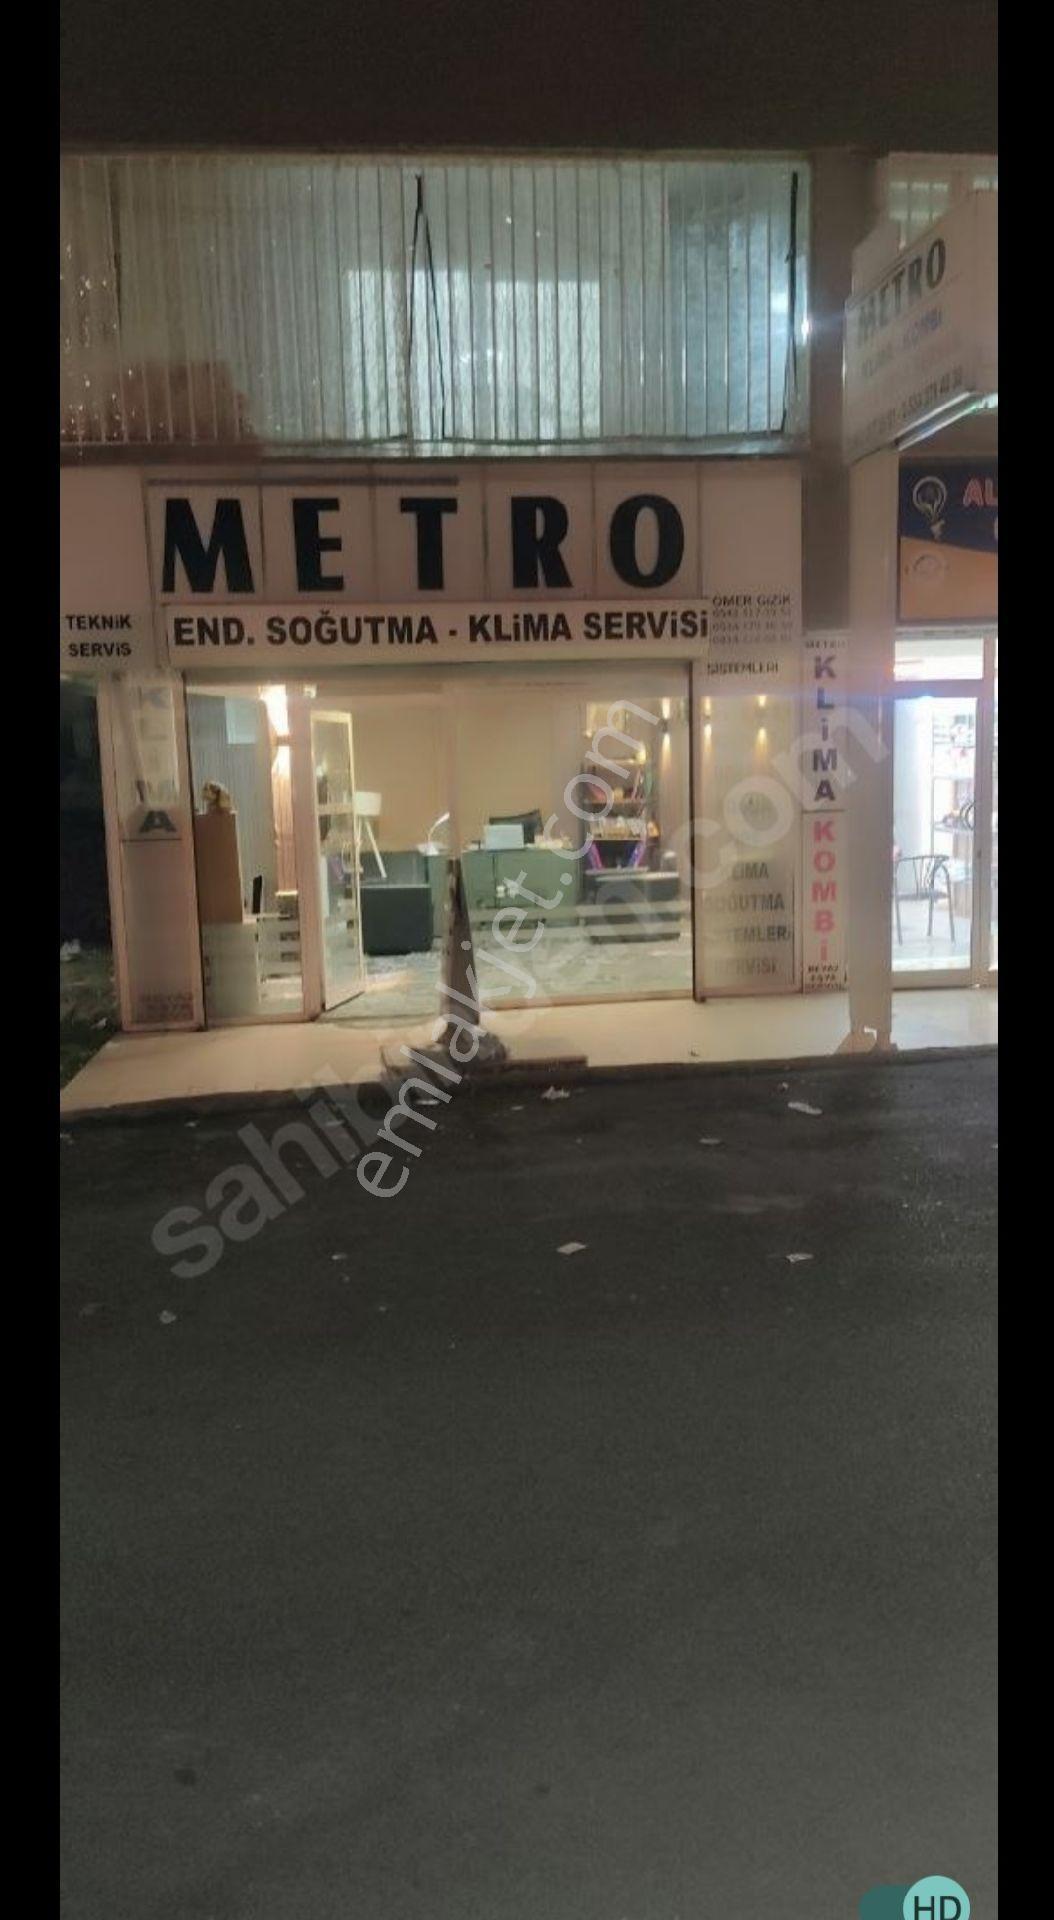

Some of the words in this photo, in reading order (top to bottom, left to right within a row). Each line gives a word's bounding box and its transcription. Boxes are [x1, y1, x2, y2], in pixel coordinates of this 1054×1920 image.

[162, 494, 684, 593] METRO
[173, 617, 255, 646] END.
[266, 610, 439, 645] SOĞUTMA
